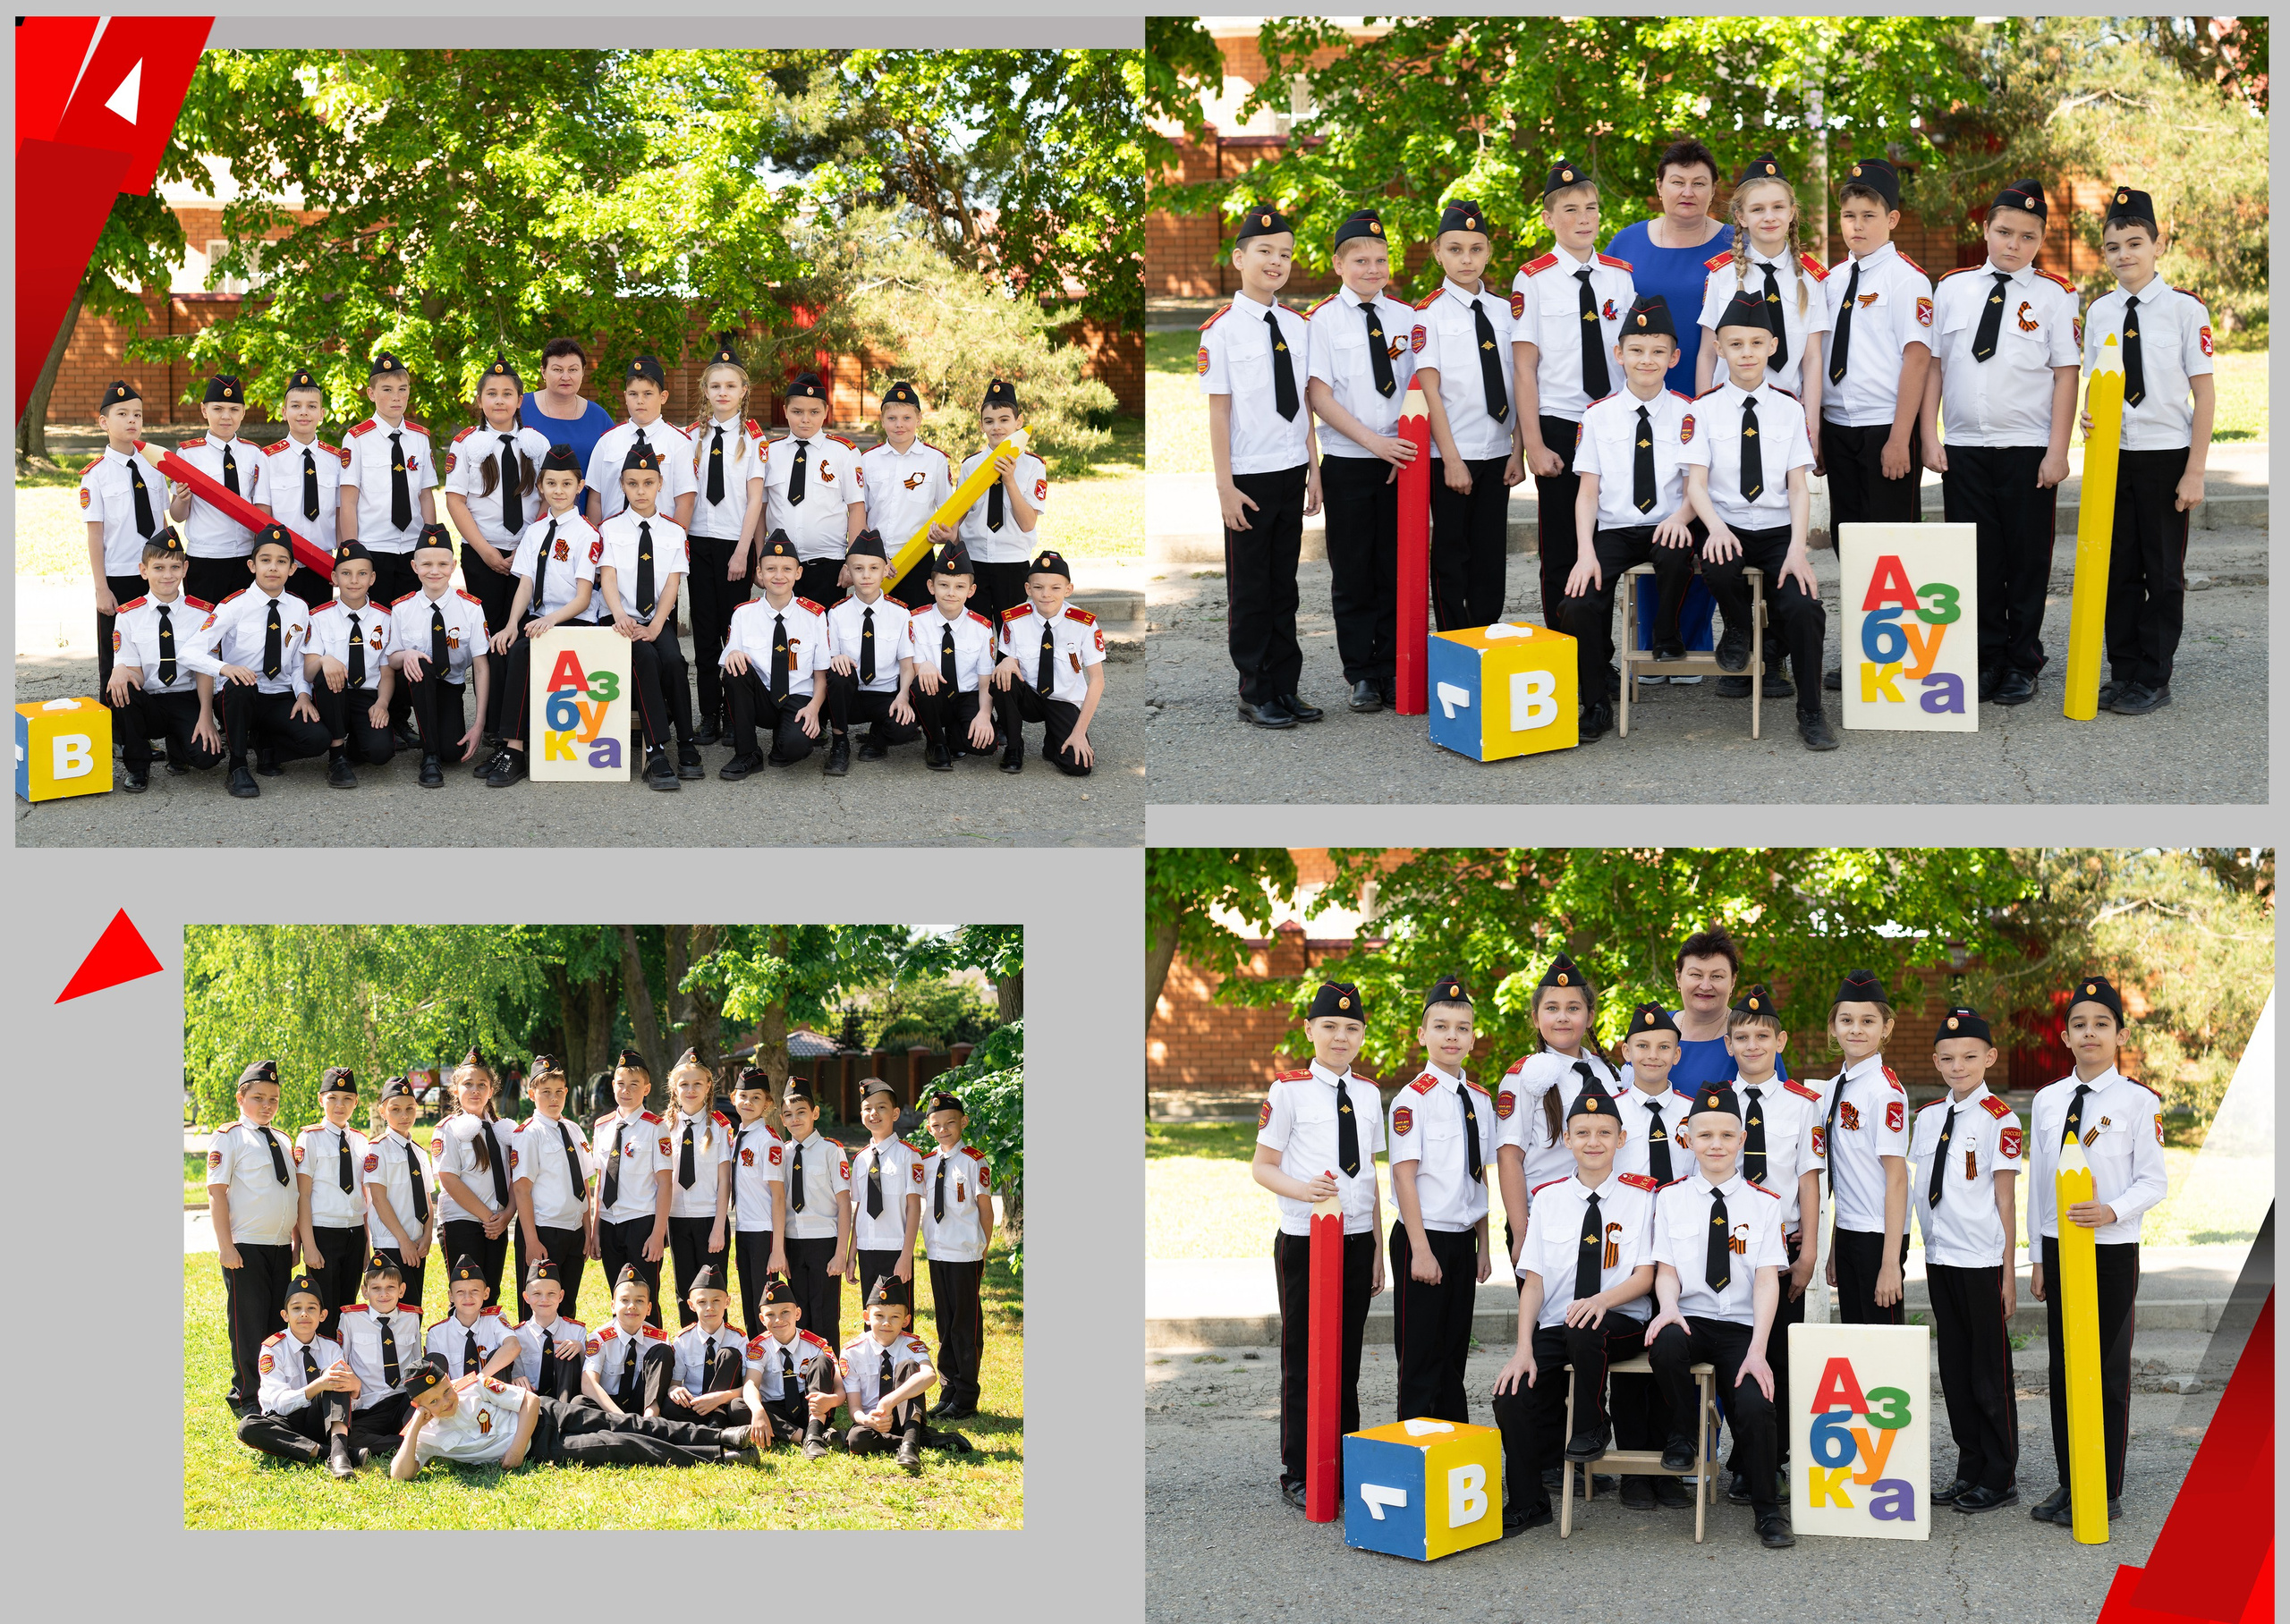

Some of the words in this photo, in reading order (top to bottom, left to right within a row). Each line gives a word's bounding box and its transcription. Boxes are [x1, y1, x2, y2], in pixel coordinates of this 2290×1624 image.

[1709, 258, 1722, 267] КК
[1524, 263, 1537, 273] КК
[1812, 266, 1825, 276] КК
[1083, 613, 1093, 623] КК
[1414, 1081, 1427, 1090] КК
[1993, 1105, 2006, 1114] КК
[1640, 1176, 1651, 1187] КК
